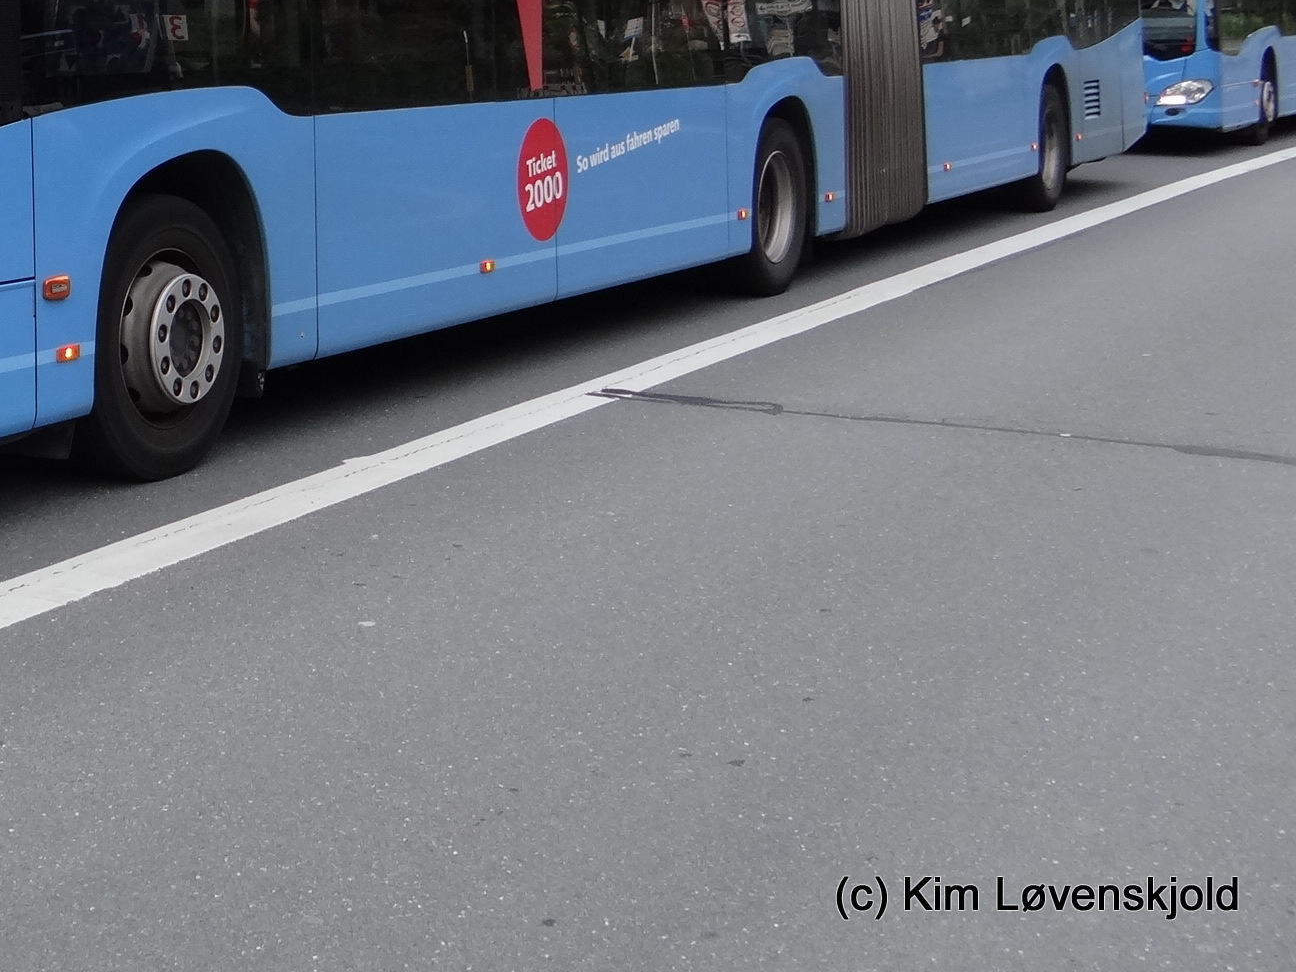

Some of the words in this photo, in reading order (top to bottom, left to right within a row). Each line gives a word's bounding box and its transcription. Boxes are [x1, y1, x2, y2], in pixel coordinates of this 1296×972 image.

[526, 149, 557, 178] Ticket
[576, 154, 589, 173] So
[589, 143, 609, 167] wird
[610, 141, 625, 159] aus
[626, 131, 653, 151] fahren
[654, 118, 680, 144] sparen
[524, 171, 563, 212] 2000
